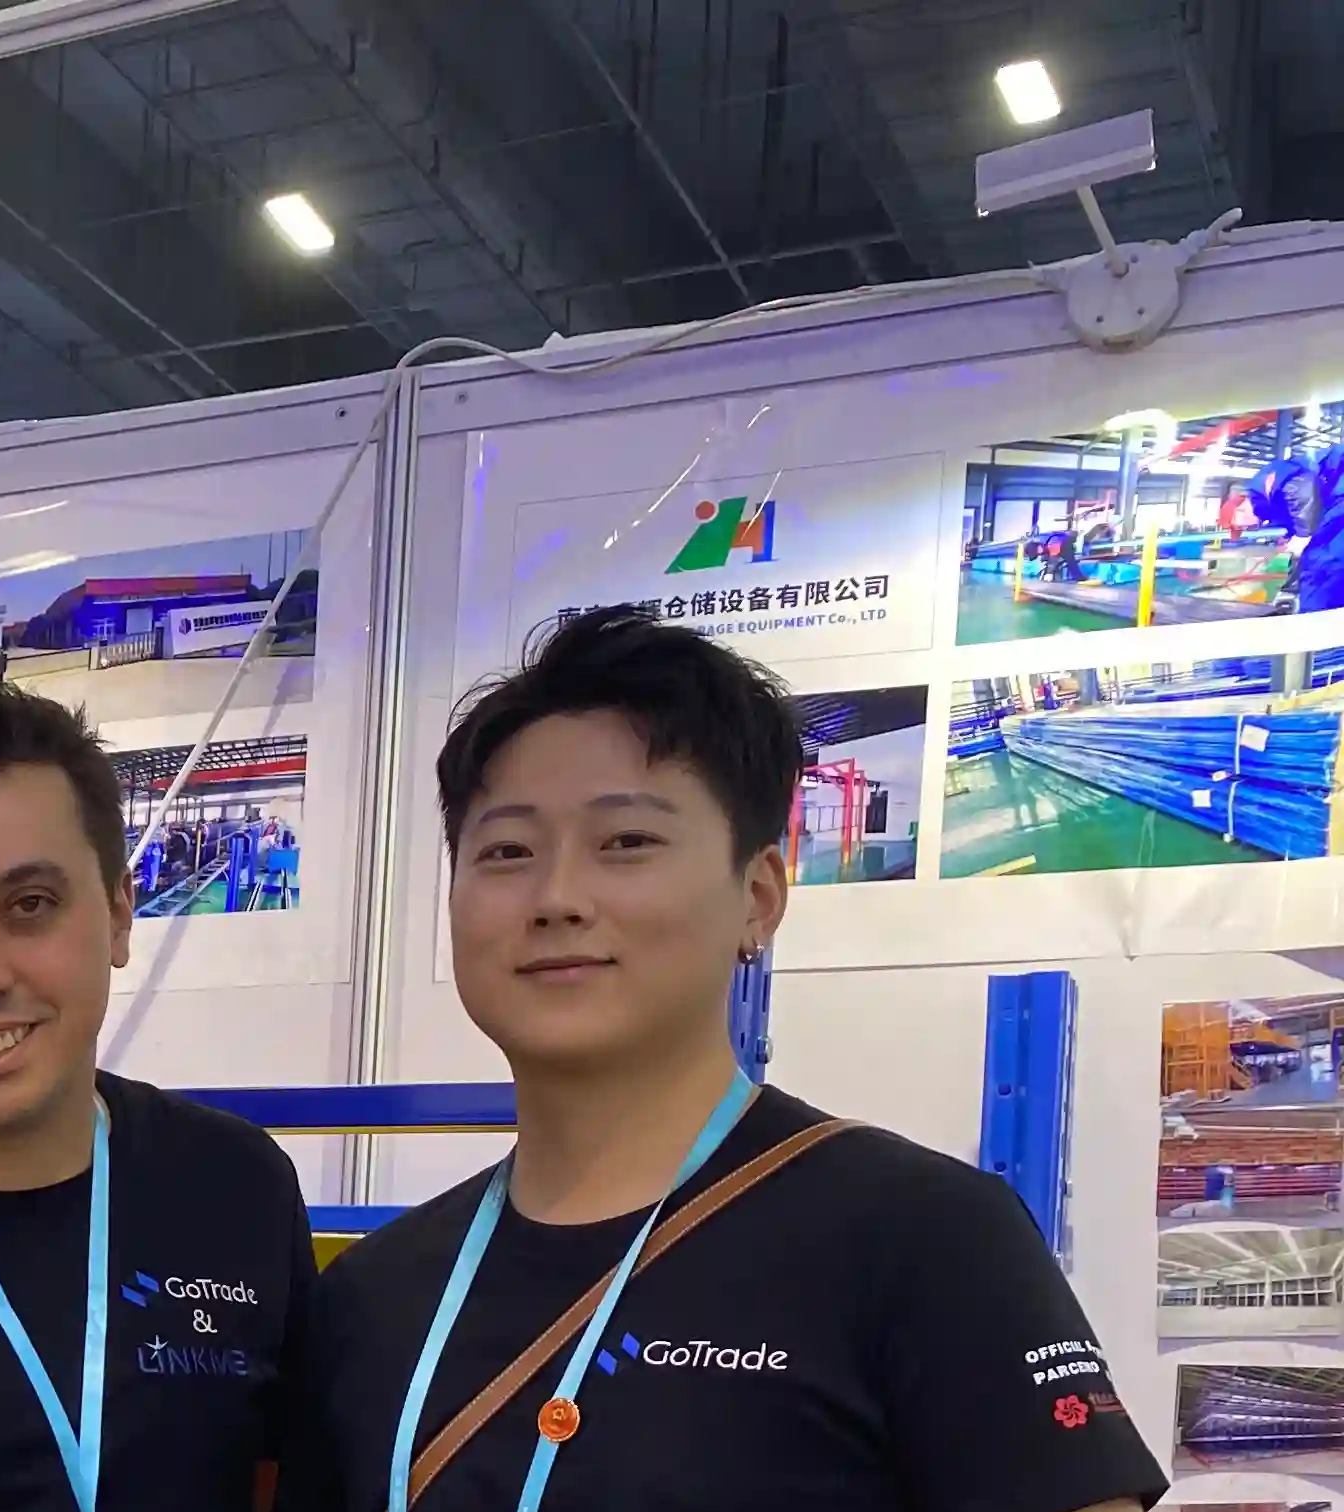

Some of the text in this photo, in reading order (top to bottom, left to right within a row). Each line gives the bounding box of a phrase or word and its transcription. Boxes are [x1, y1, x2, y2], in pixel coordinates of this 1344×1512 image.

[738, 614, 826, 634] EQUIPMENT
[860, 608, 888, 622] LTD
[165, 1276, 258, 1305] GoTrade
[192, 1309, 218, 1333] &
[642, 1340, 789, 1371] GoTrade
